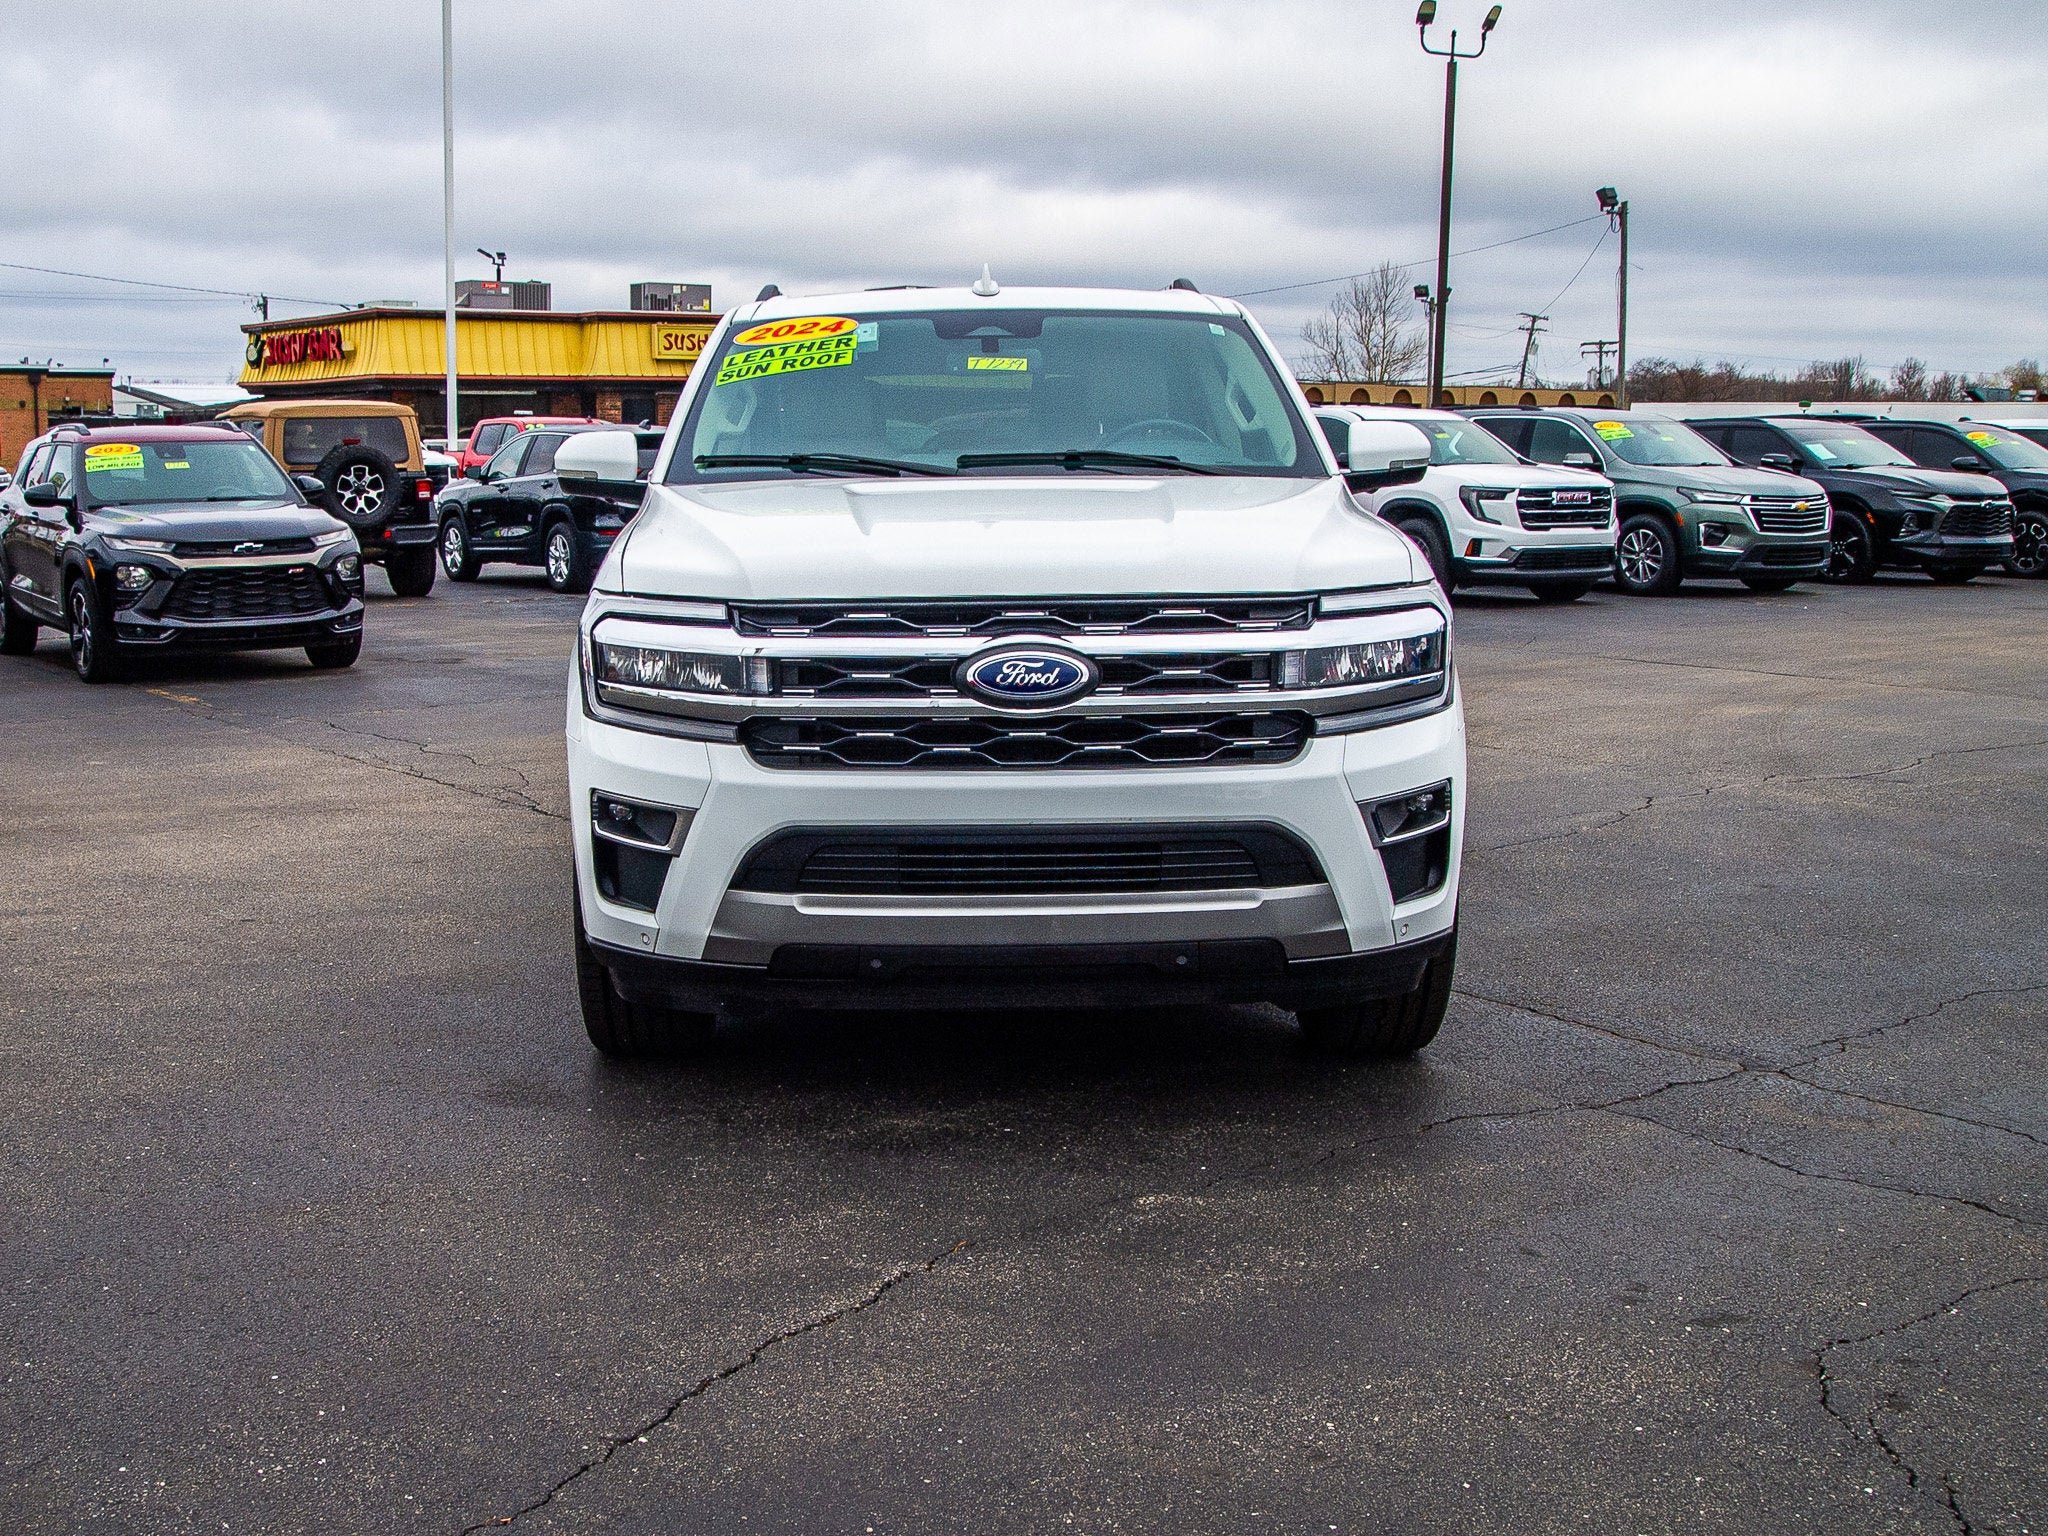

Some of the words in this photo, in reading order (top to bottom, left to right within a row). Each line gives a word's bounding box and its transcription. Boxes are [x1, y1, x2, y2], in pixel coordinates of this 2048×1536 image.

[265, 333, 307, 366] SUSHI
[308, 326, 344, 361] BAR
[745, 320, 847, 343] 2024
[726, 337, 853, 367] LEATHER
[719, 362, 771, 383] SUN
[781, 352, 848, 371] ROOF
[996, 660, 1060, 686] Ford
